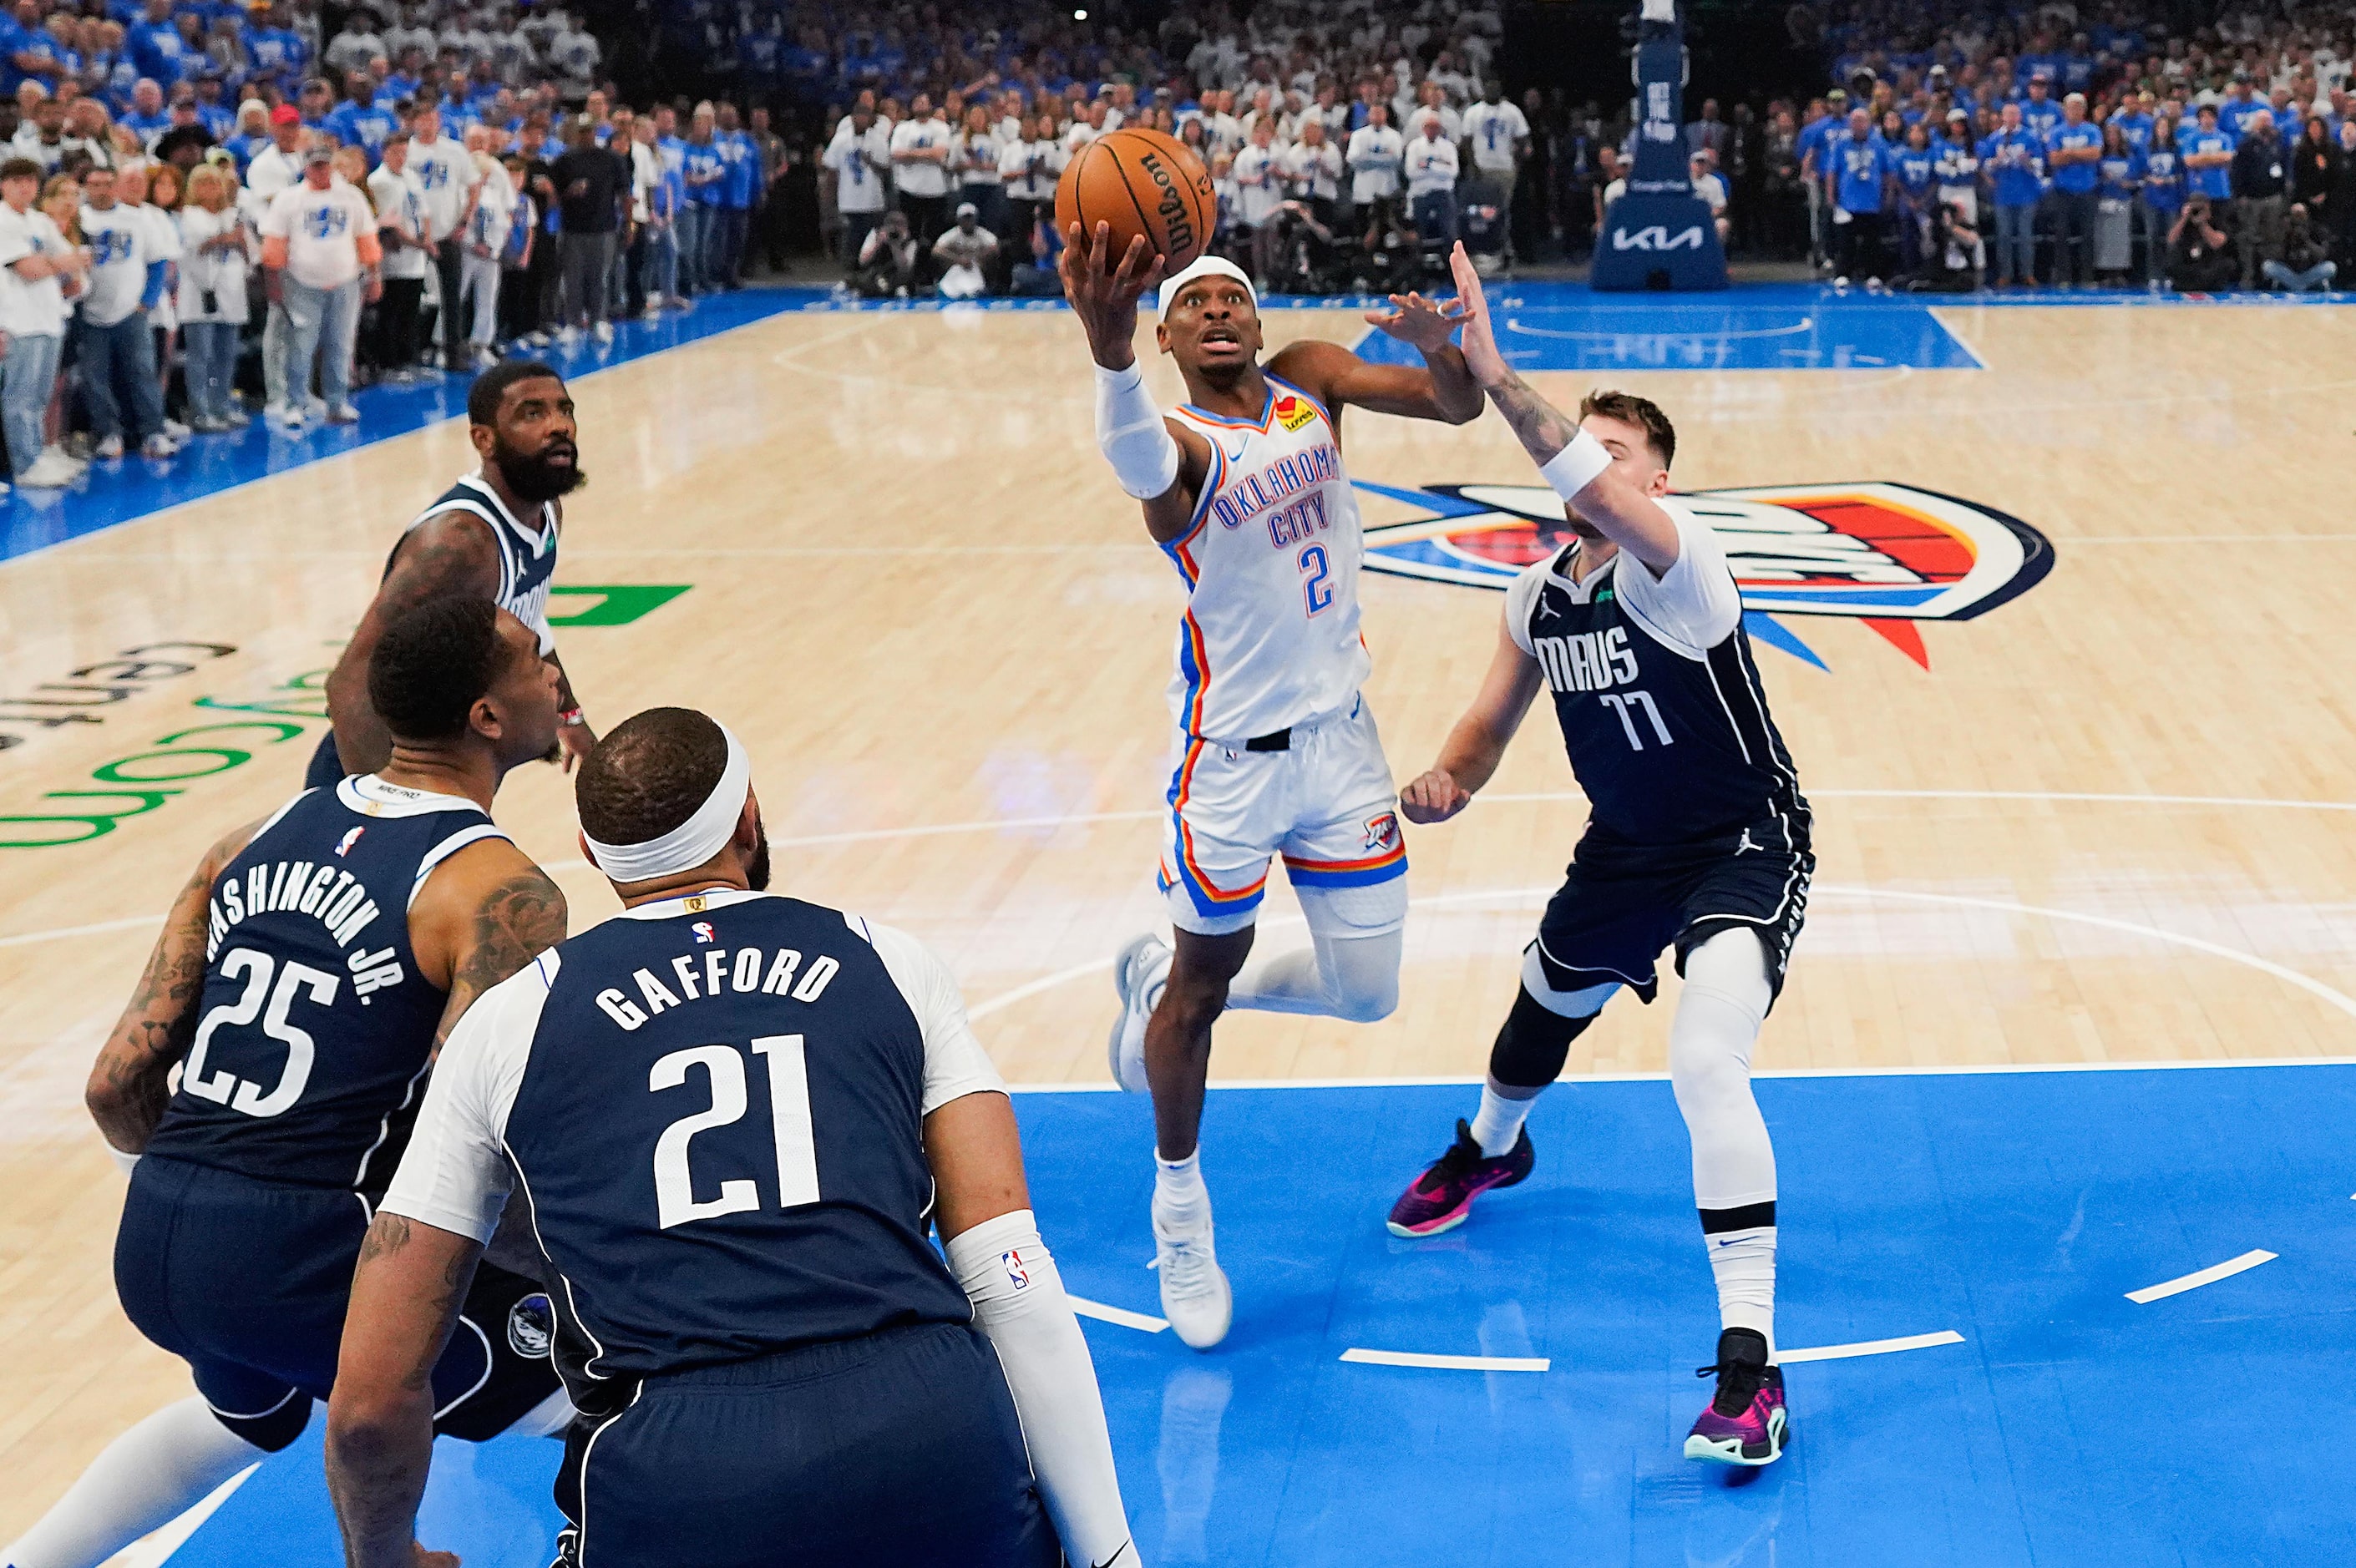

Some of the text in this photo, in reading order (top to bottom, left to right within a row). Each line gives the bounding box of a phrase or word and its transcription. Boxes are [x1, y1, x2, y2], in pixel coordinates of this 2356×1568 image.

[1140, 151, 1193, 255] Wilson
[1613, 225, 1704, 250] KIA
[1211, 443, 1340, 530] OKLAHOMA
[1267, 490, 1330, 549] CITY
[1297, 541, 1336, 620] 2
[1533, 625, 1639, 692] MAVS
[1599, 690, 1675, 751] 77
[347, 946, 404, 1005] JR.
[595, 947, 840, 1031] GAFFORD
[183, 947, 340, 1118] 25
[649, 1034, 821, 1231] 21
